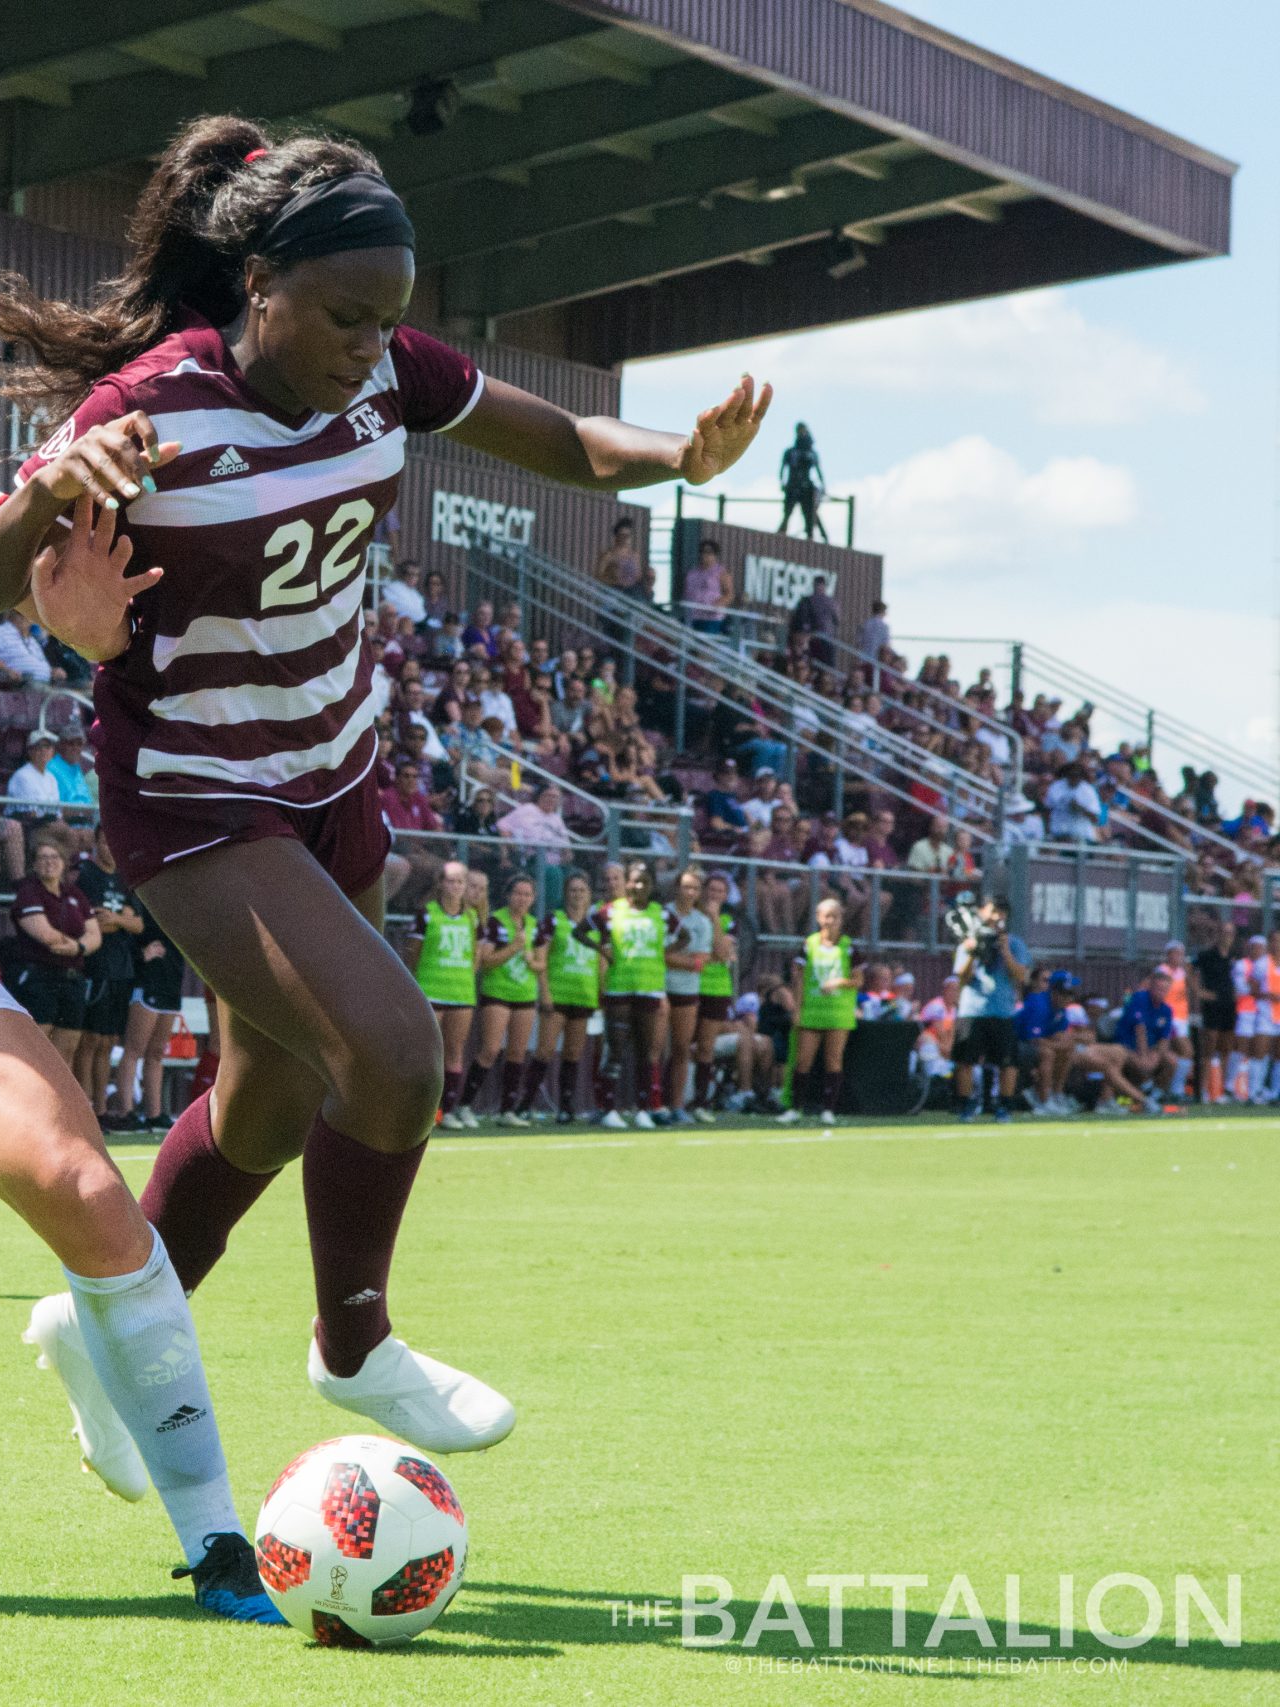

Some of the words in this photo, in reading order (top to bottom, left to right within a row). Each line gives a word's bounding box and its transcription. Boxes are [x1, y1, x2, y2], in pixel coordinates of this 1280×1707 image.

[210, 461, 250, 477] adidas
[260, 498, 375, 611] 22
[155, 1408, 208, 1434] adidas
